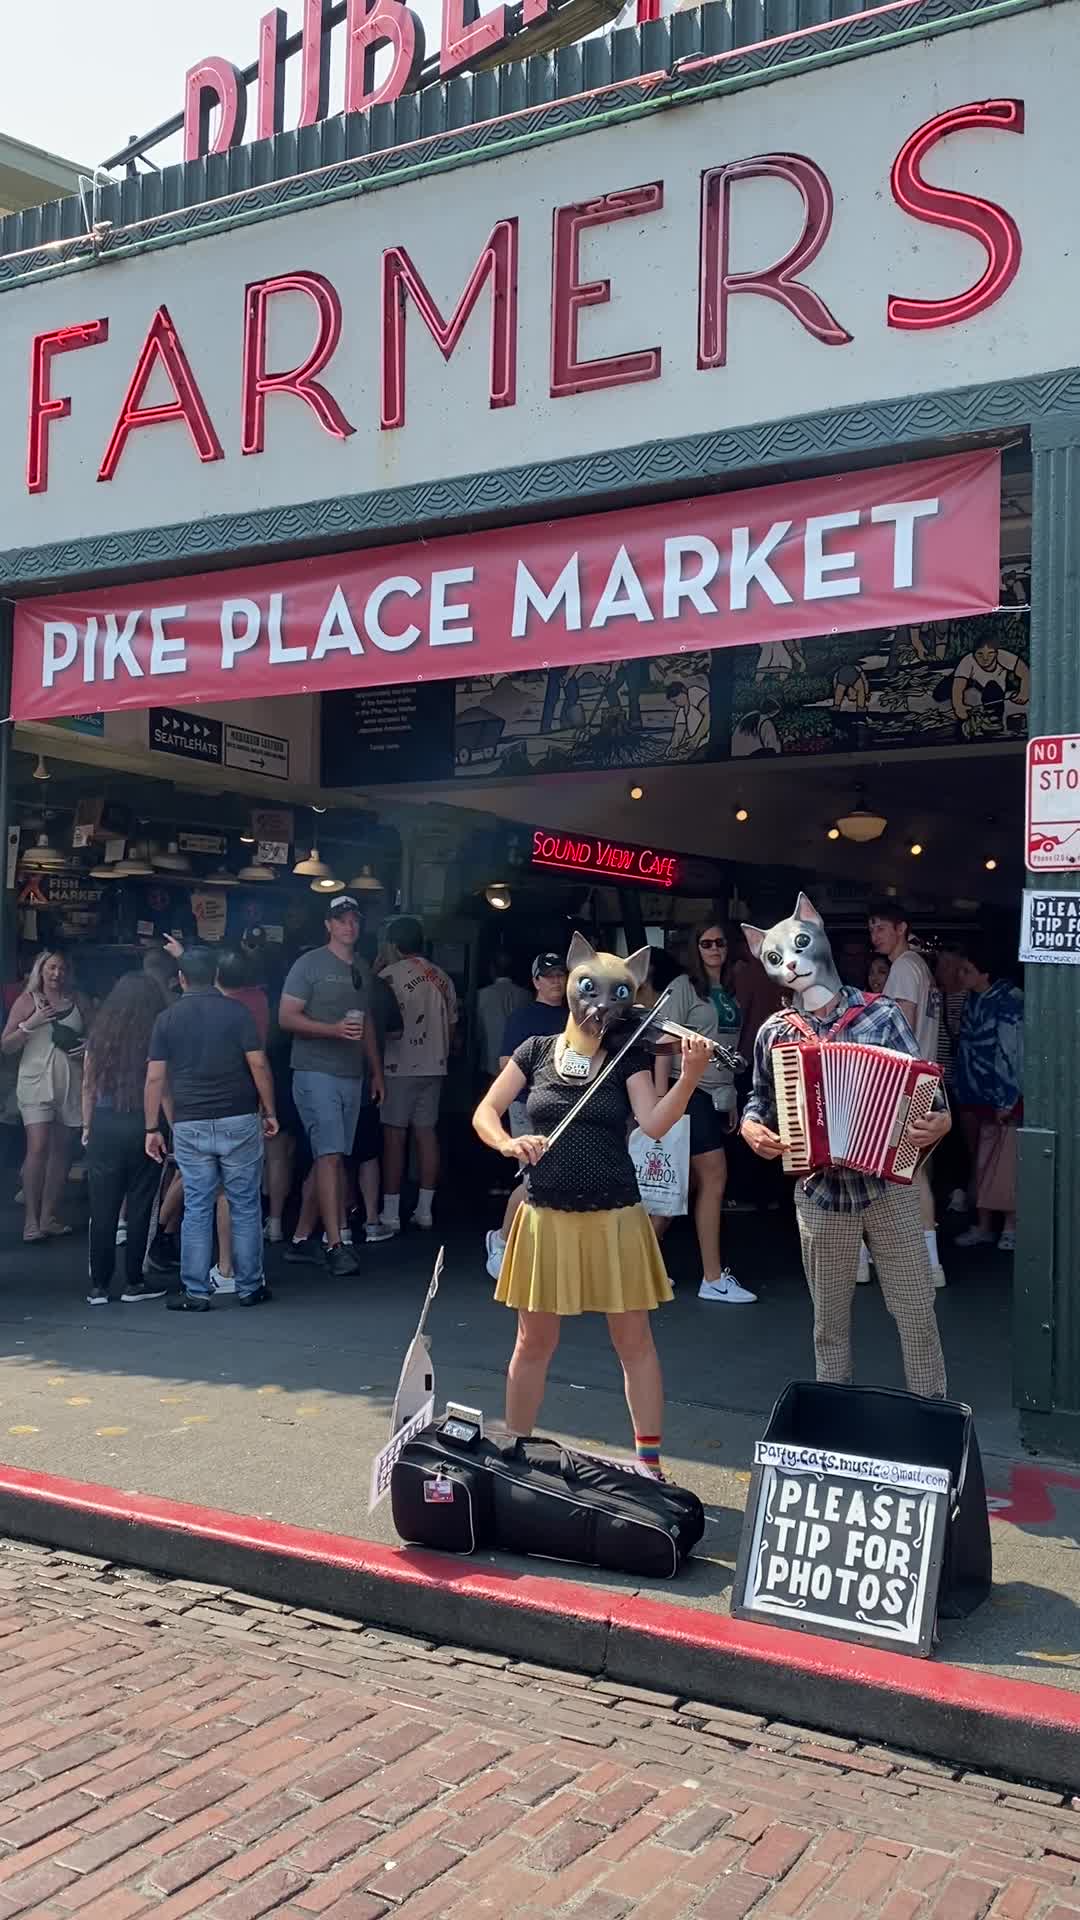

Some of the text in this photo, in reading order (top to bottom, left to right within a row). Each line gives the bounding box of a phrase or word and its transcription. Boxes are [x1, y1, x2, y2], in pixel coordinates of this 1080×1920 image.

[26, 98, 1026, 495] FARMERS
[42, 497, 940, 688] PIKE PLACE MARKET
[1034, 743, 1057, 761] NO
[532, 831, 677, 877] SOUND VIEW CAFE
[49, 879, 79, 889] FISH
[49, 890, 103, 901] MARKET
[1035, 917, 1062, 931] TIP
[779, 1479, 916, 1535] PLEASE
[774, 1517, 911, 1578] TIP FOR
[766, 1555, 907, 1615] PHOTOS
